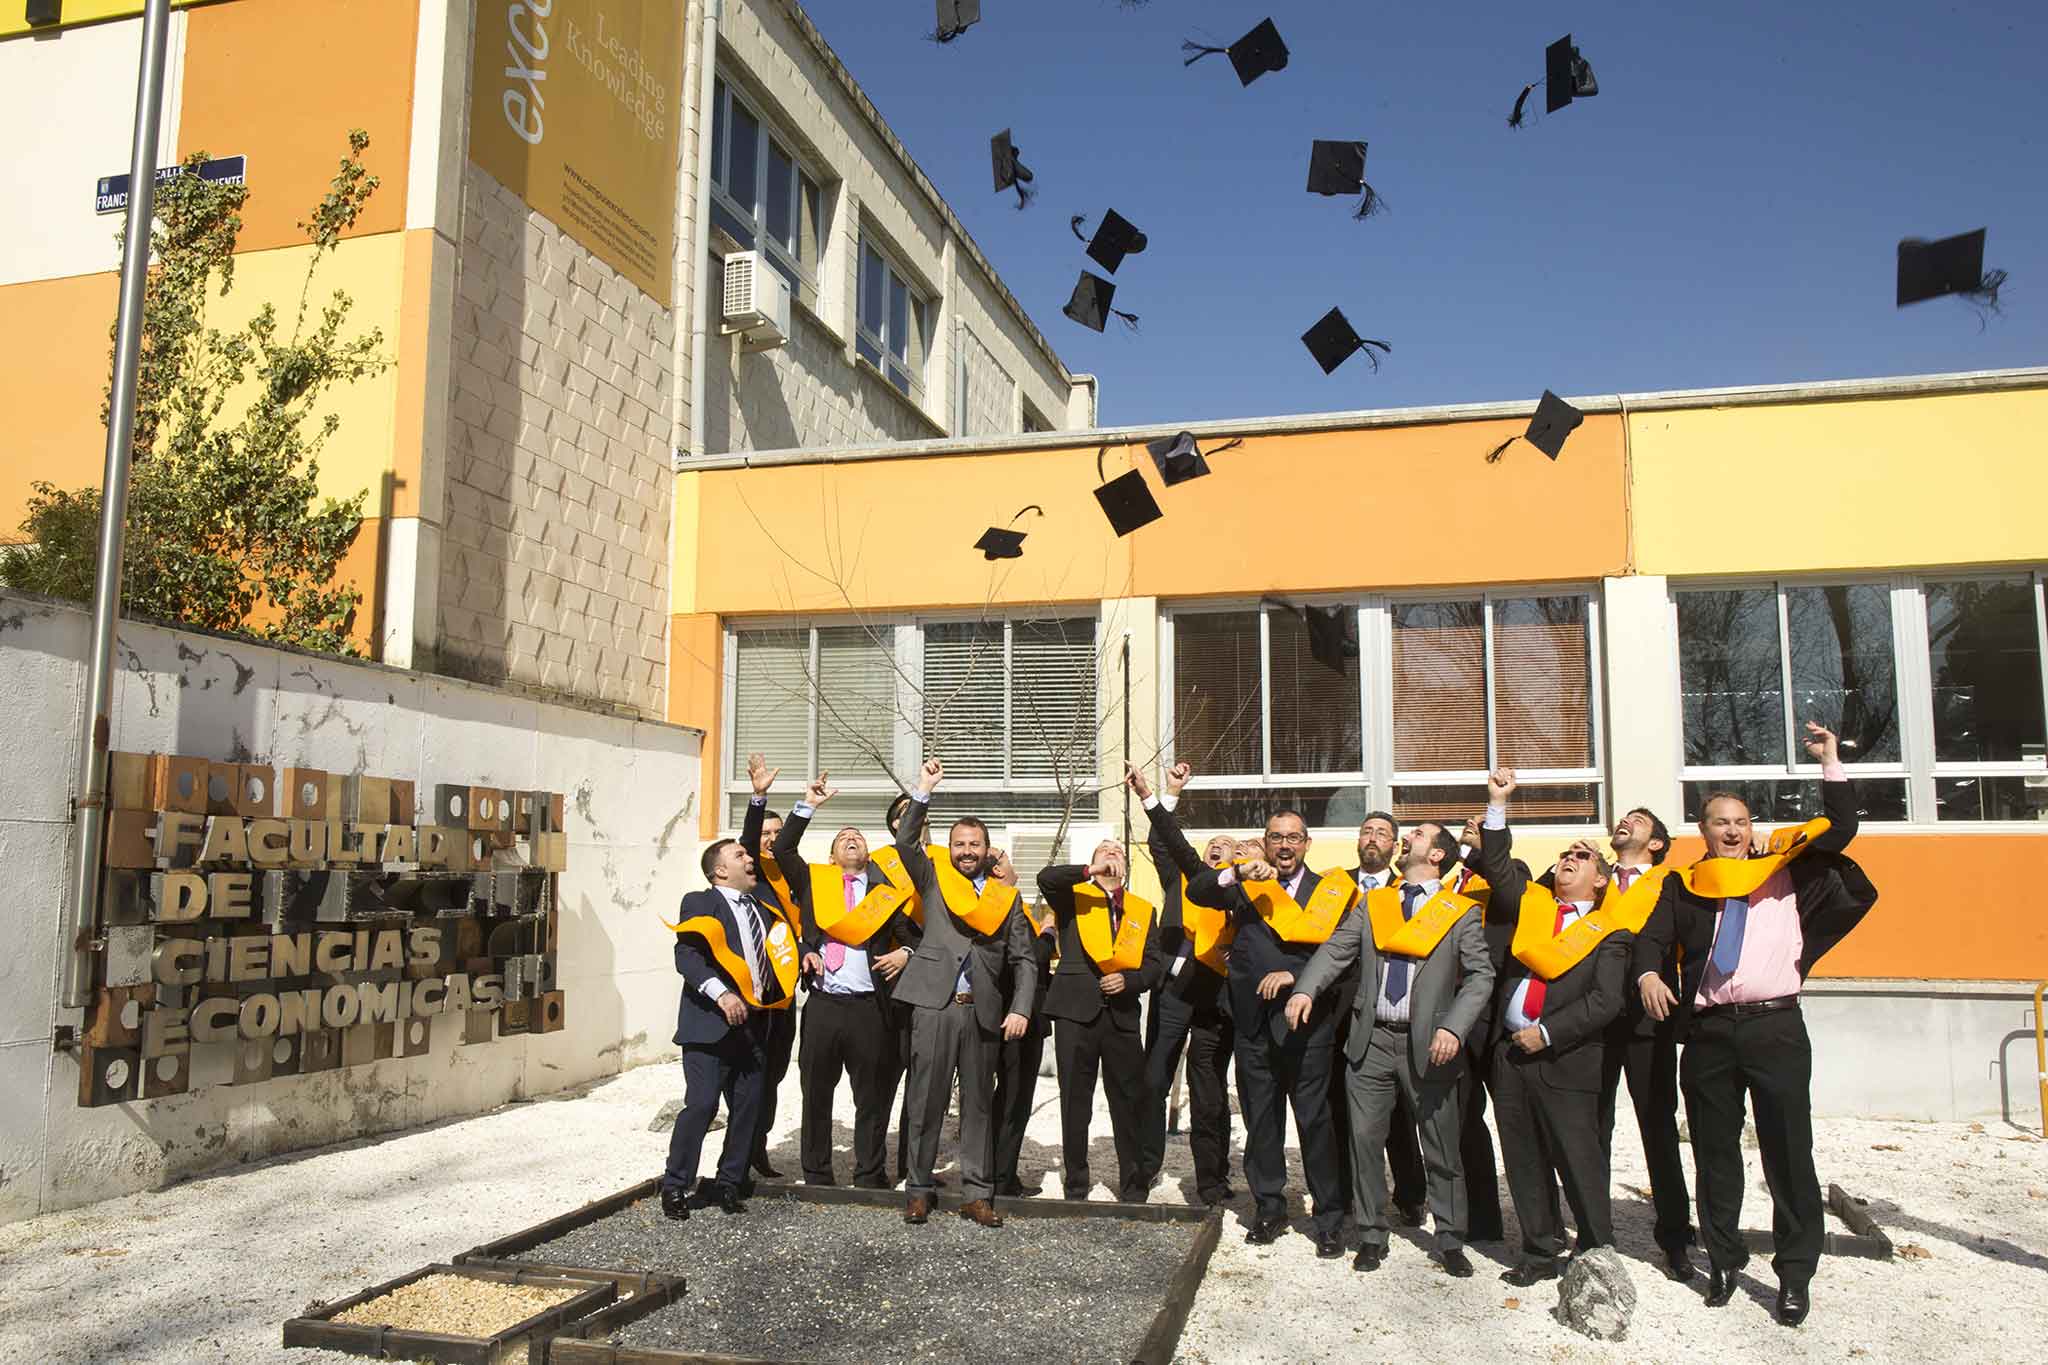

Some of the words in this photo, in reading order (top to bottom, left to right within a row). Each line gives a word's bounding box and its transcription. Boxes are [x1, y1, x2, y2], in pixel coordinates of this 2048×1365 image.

[566, 19, 665, 140] Knowledge
[597, 13, 665, 113] Leading
[96, 191, 128, 209] FRANCI
[156, 812, 448, 866] FACULTAD
[160, 873, 252, 919] DE
[153, 929, 441, 984] CIENCIAS
[143, 974, 503, 1058] ECONOMICAS
